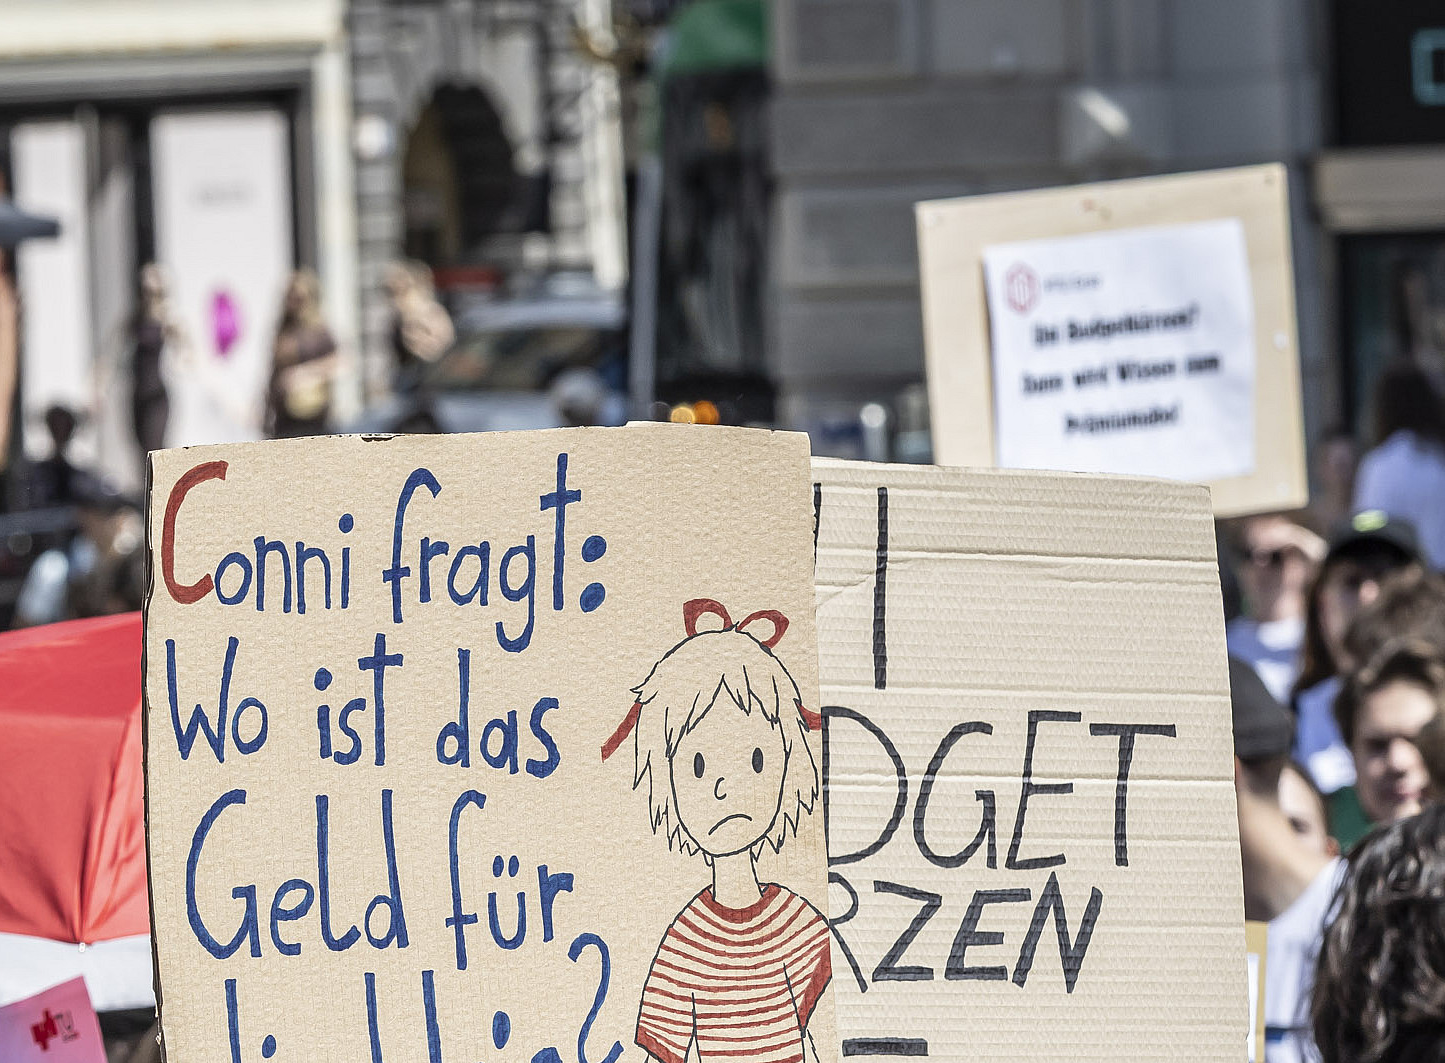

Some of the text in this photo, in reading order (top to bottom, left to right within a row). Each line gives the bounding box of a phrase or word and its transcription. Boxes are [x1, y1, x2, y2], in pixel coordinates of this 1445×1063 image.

[161, 453, 607, 652] Conni fragt:
[166, 633, 561, 778] Wo ist das
[185, 788, 574, 970] Geld für
